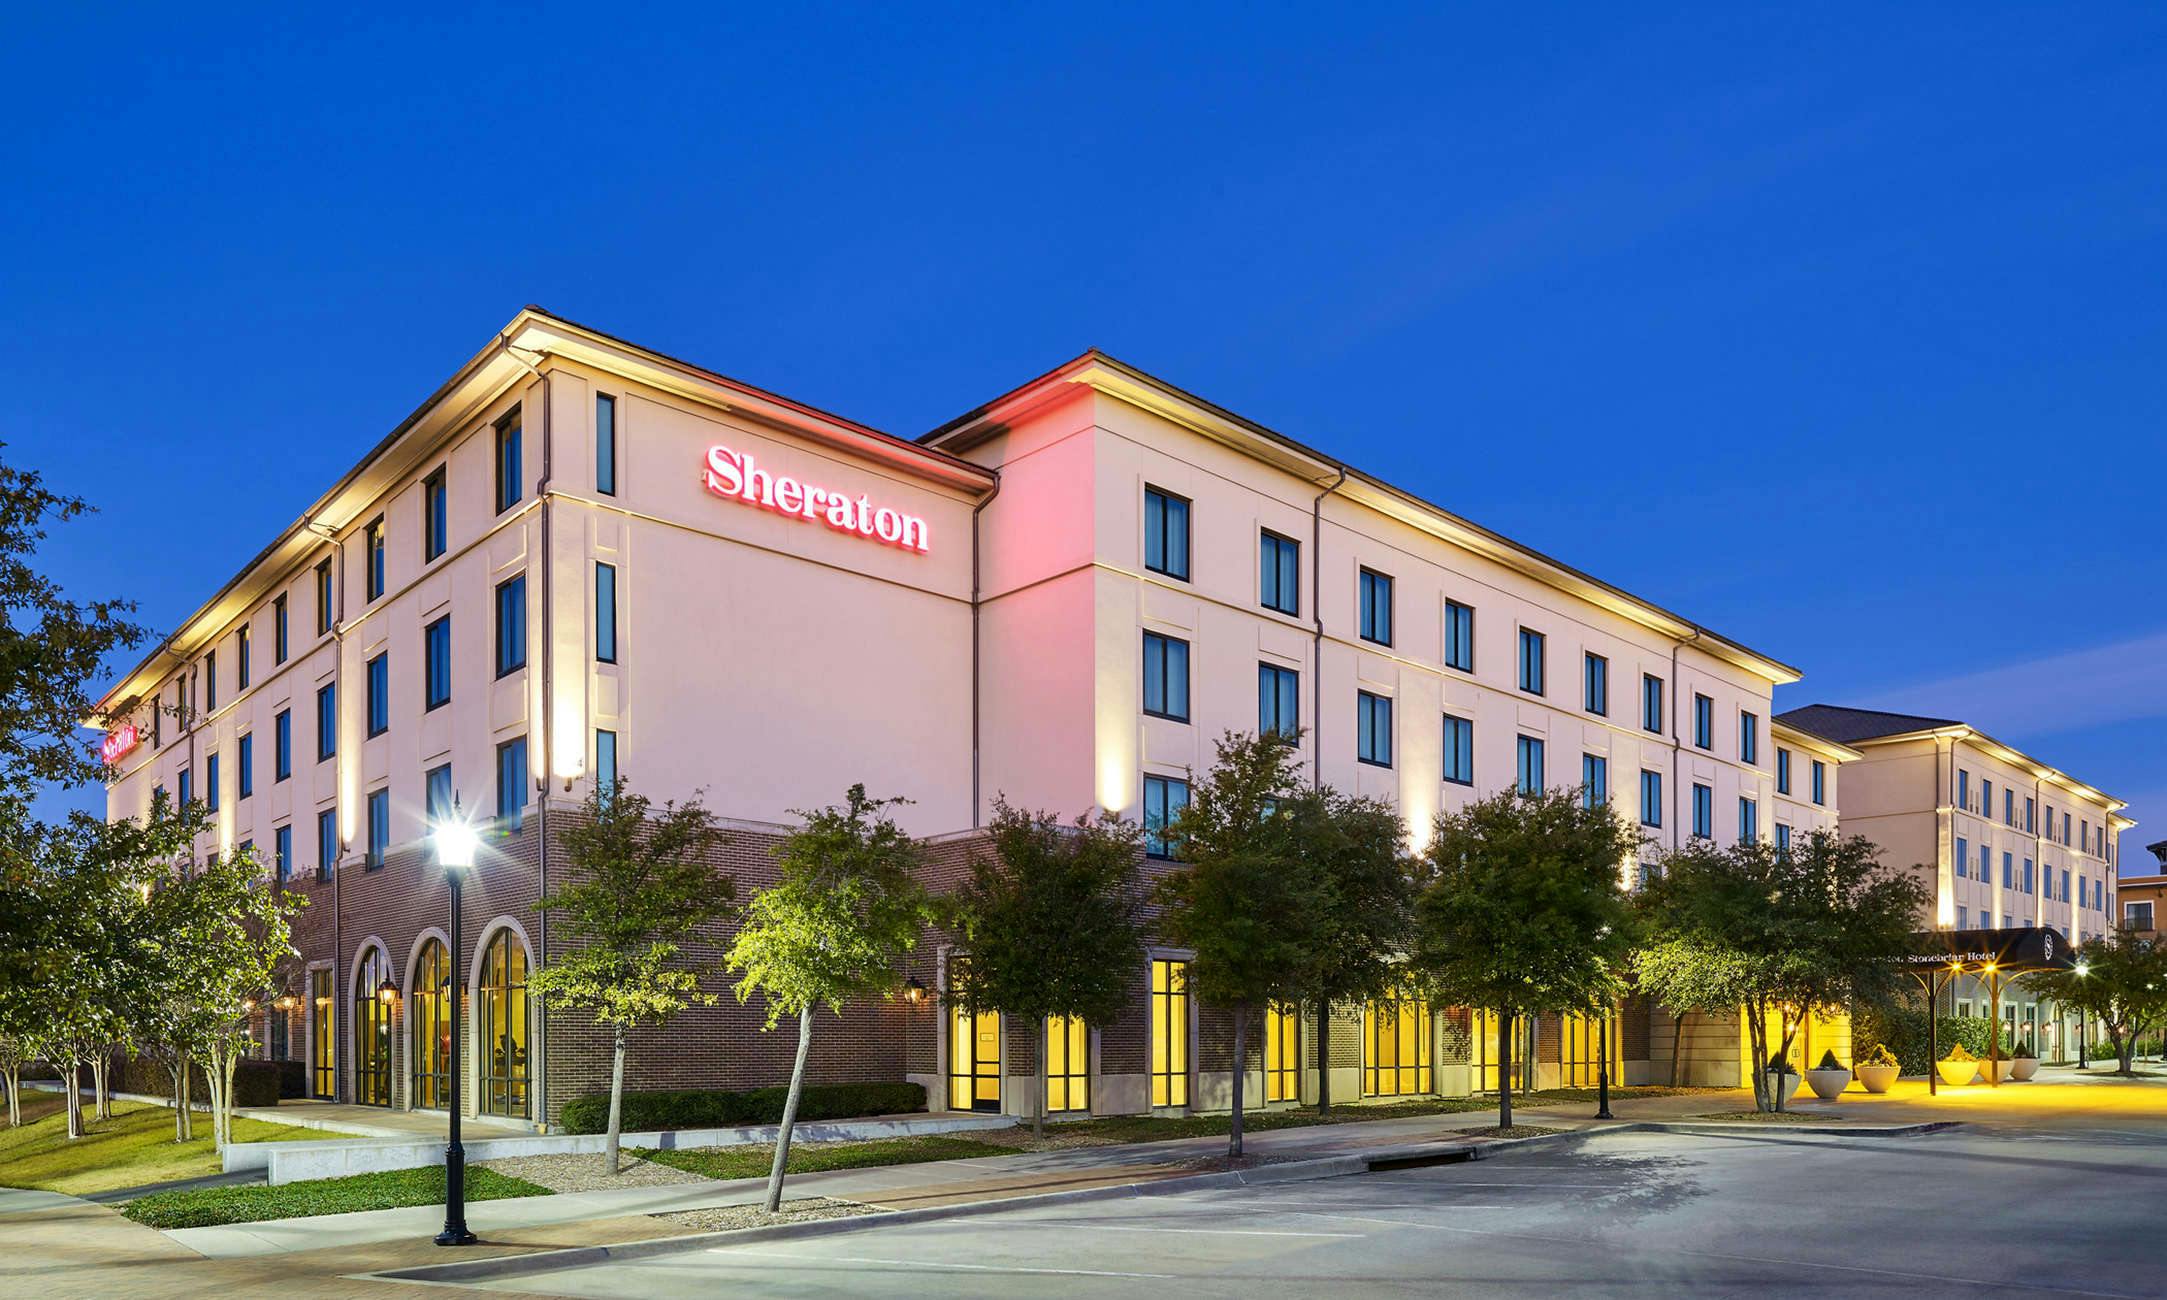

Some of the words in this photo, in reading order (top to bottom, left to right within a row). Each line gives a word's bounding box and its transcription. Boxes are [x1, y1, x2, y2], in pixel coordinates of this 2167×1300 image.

[706, 445, 929, 552] Sheraton
[1907, 952, 1965, 963] Stonebriar
[1967, 951, 1996, 961] Hotel
